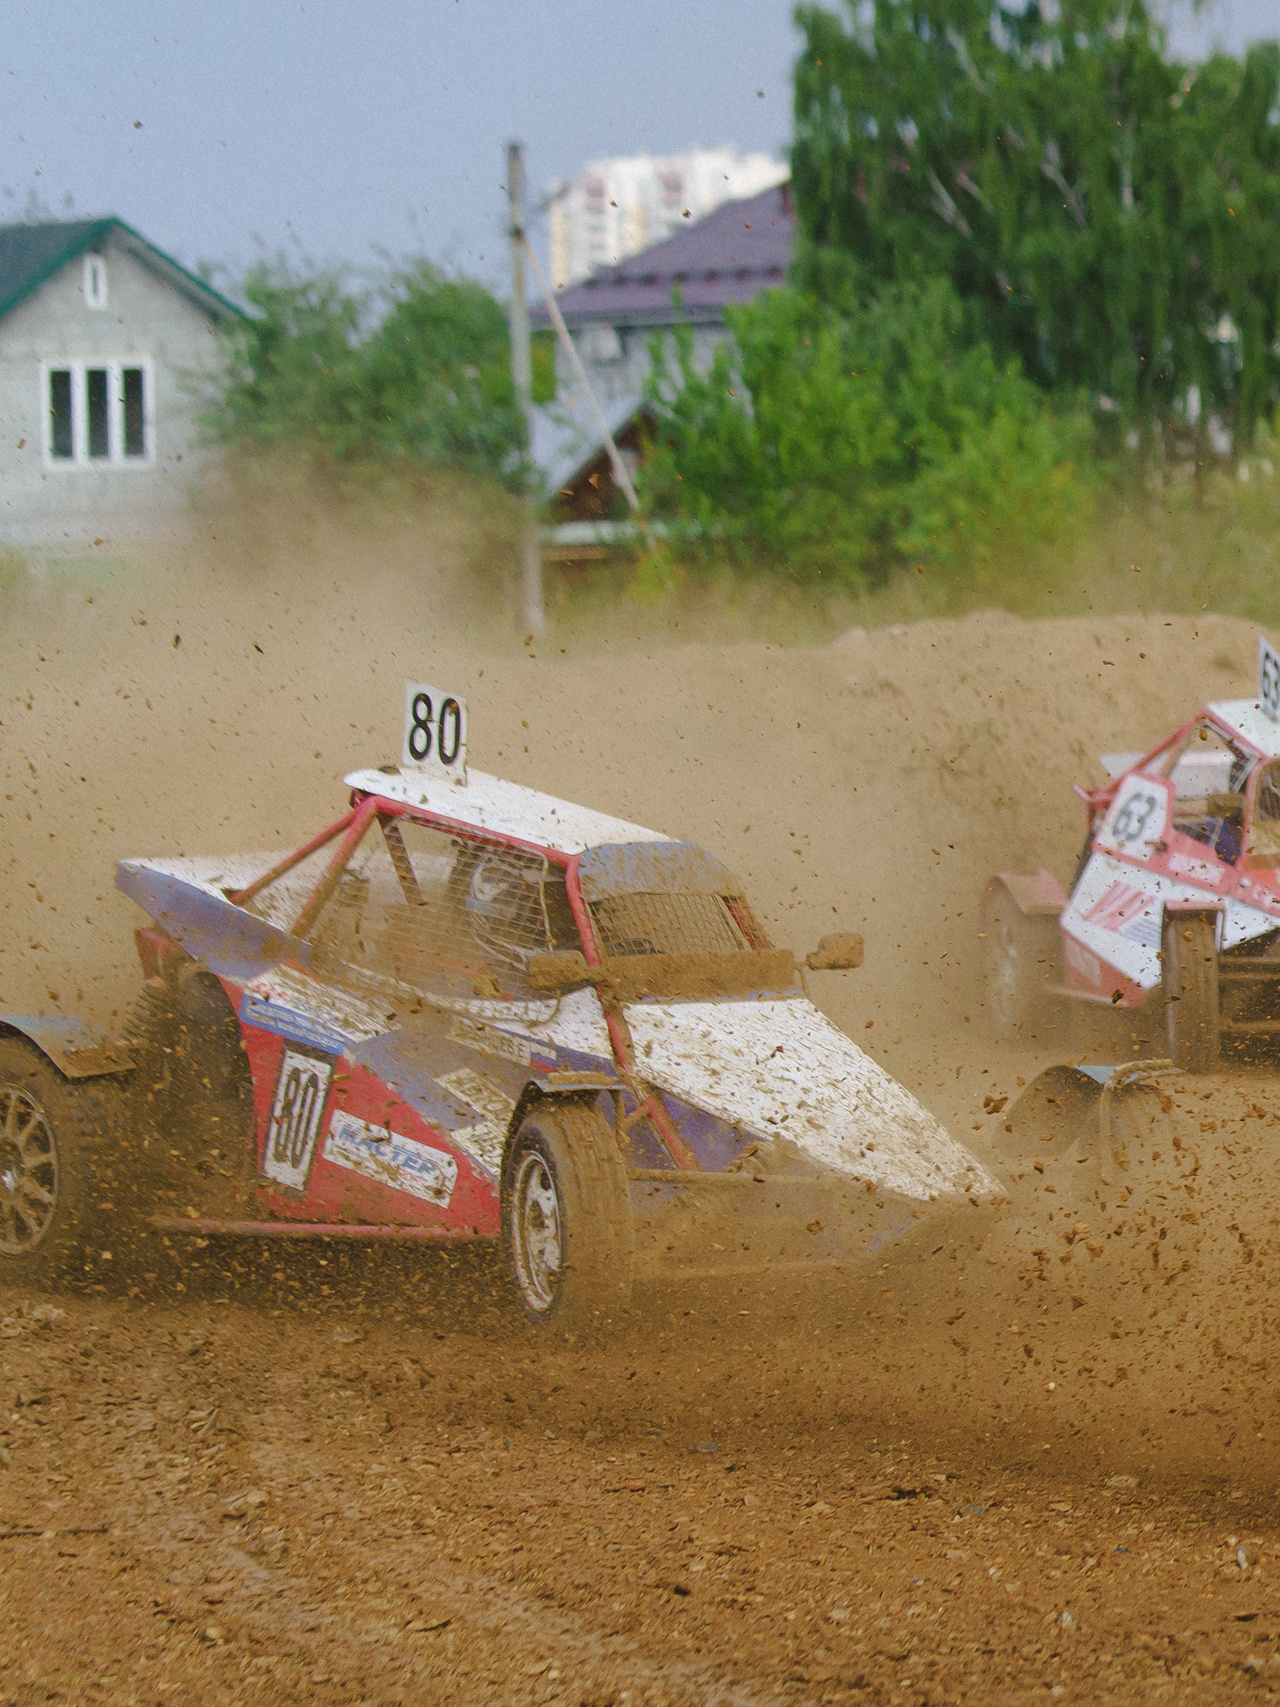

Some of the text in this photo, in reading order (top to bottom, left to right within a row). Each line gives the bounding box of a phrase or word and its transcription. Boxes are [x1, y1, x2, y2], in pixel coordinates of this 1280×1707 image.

[1263, 651, 1280, 709] 63
[408, 693, 460, 764] 80
[1112, 792, 1156, 841] 63
[273, 1067, 318, 1169] 80
